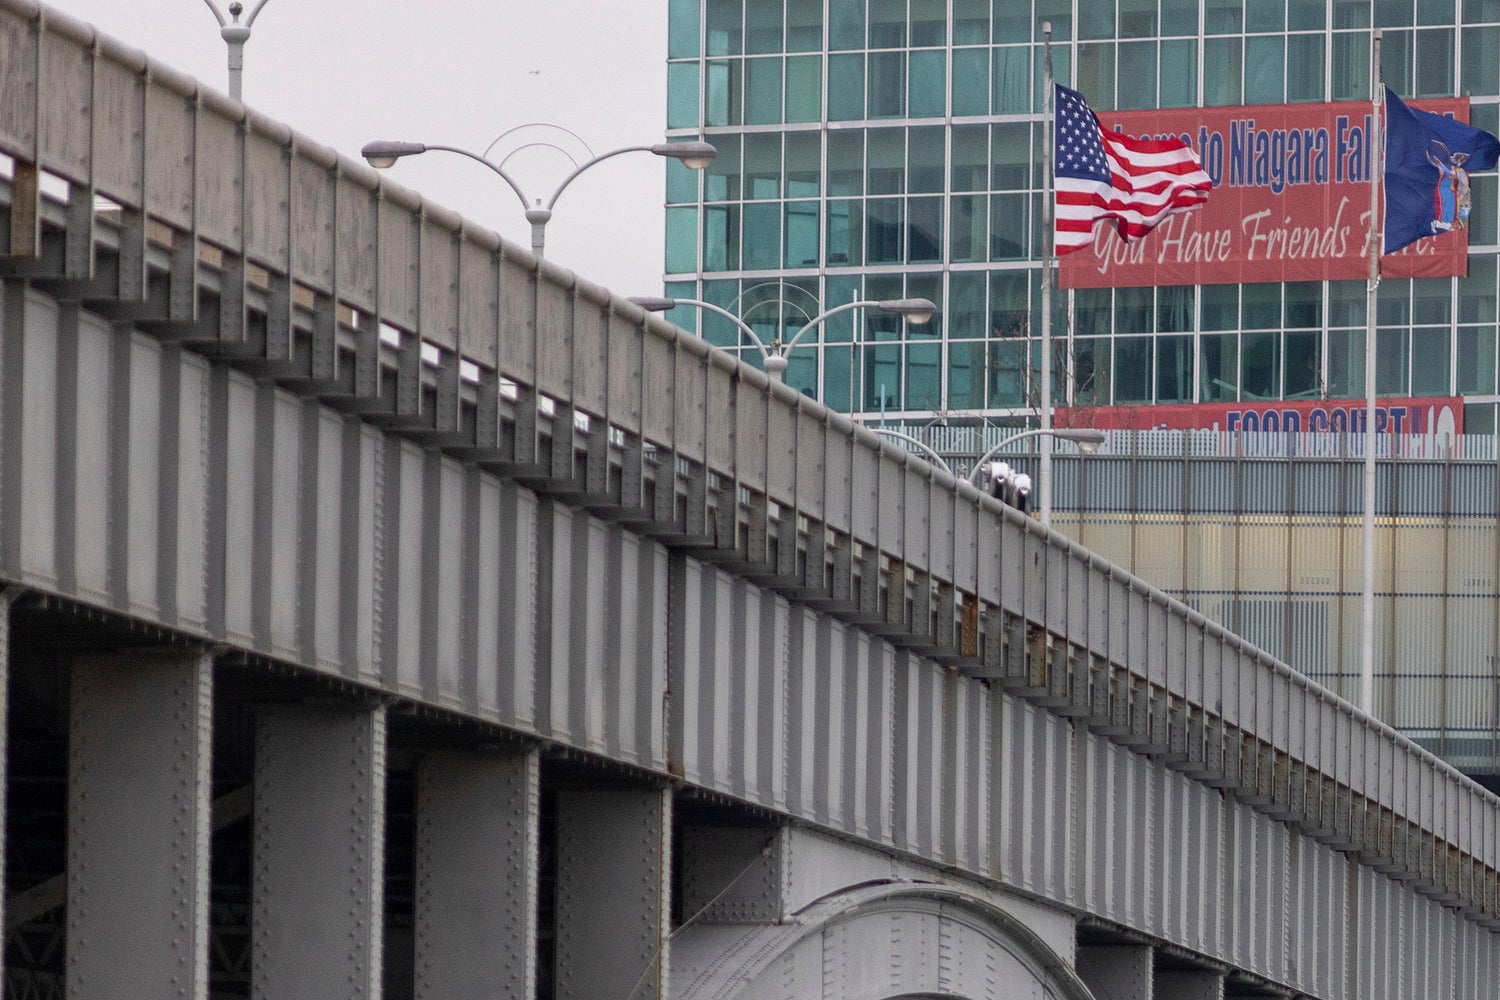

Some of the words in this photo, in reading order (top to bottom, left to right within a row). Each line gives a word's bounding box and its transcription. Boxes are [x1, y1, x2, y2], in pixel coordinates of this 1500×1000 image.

[1199, 125, 1224, 189] to
[1229, 118, 1330, 195] Niagara
[1156, 210, 1231, 265] Have
[1242, 196, 1350, 261] Friends
